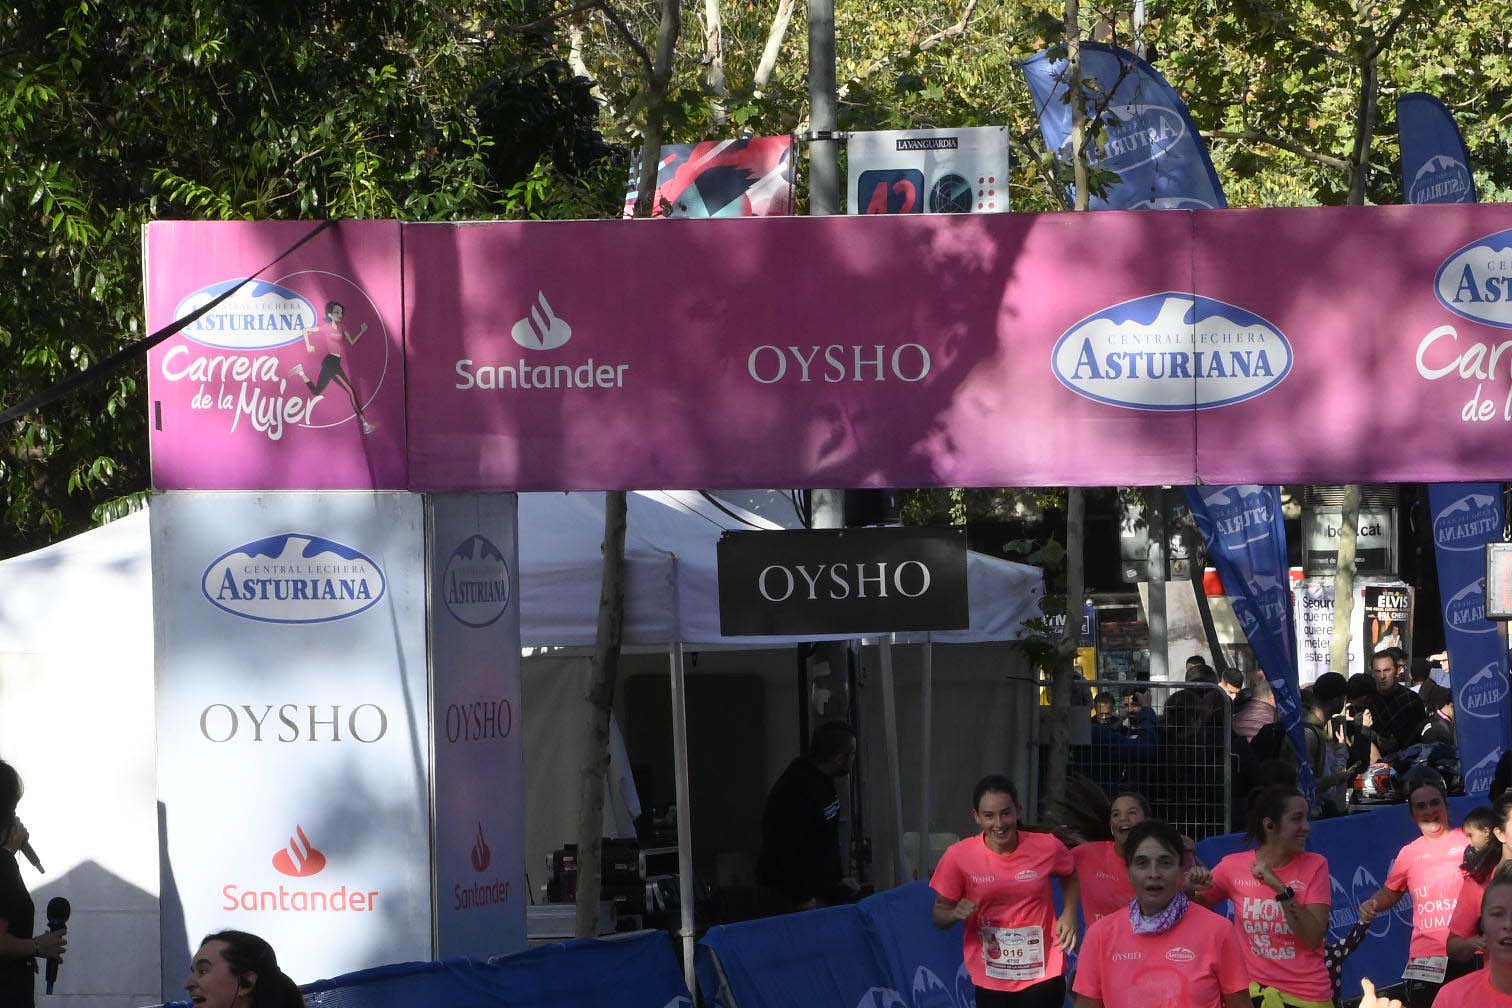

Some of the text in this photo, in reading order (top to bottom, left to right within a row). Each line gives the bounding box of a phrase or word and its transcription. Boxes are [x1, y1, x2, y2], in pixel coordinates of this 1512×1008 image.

[1107, 330, 1266, 345] CENTRAL LECHERA
[161, 345, 280, 382] Carrera
[455, 358, 630, 390] Santander
[747, 343, 932, 384] OYSHO
[1071, 336, 1273, 380] ASTURIANA
[190, 378, 325, 441] de la Mujer
[1461, 383, 1495, 422] de
[217, 566, 373, 602] ASTURIANA
[244, 563, 366, 574] CENTRAL LECHERA
[758, 559, 932, 602] OYSHO
[199, 702, 388, 744] OYSHO
[445, 698, 512, 744] OYSHO
[221, 883, 379, 912] Santander
[454, 880, 511, 912] Santander
[1003, 948, 1024, 958] 016
